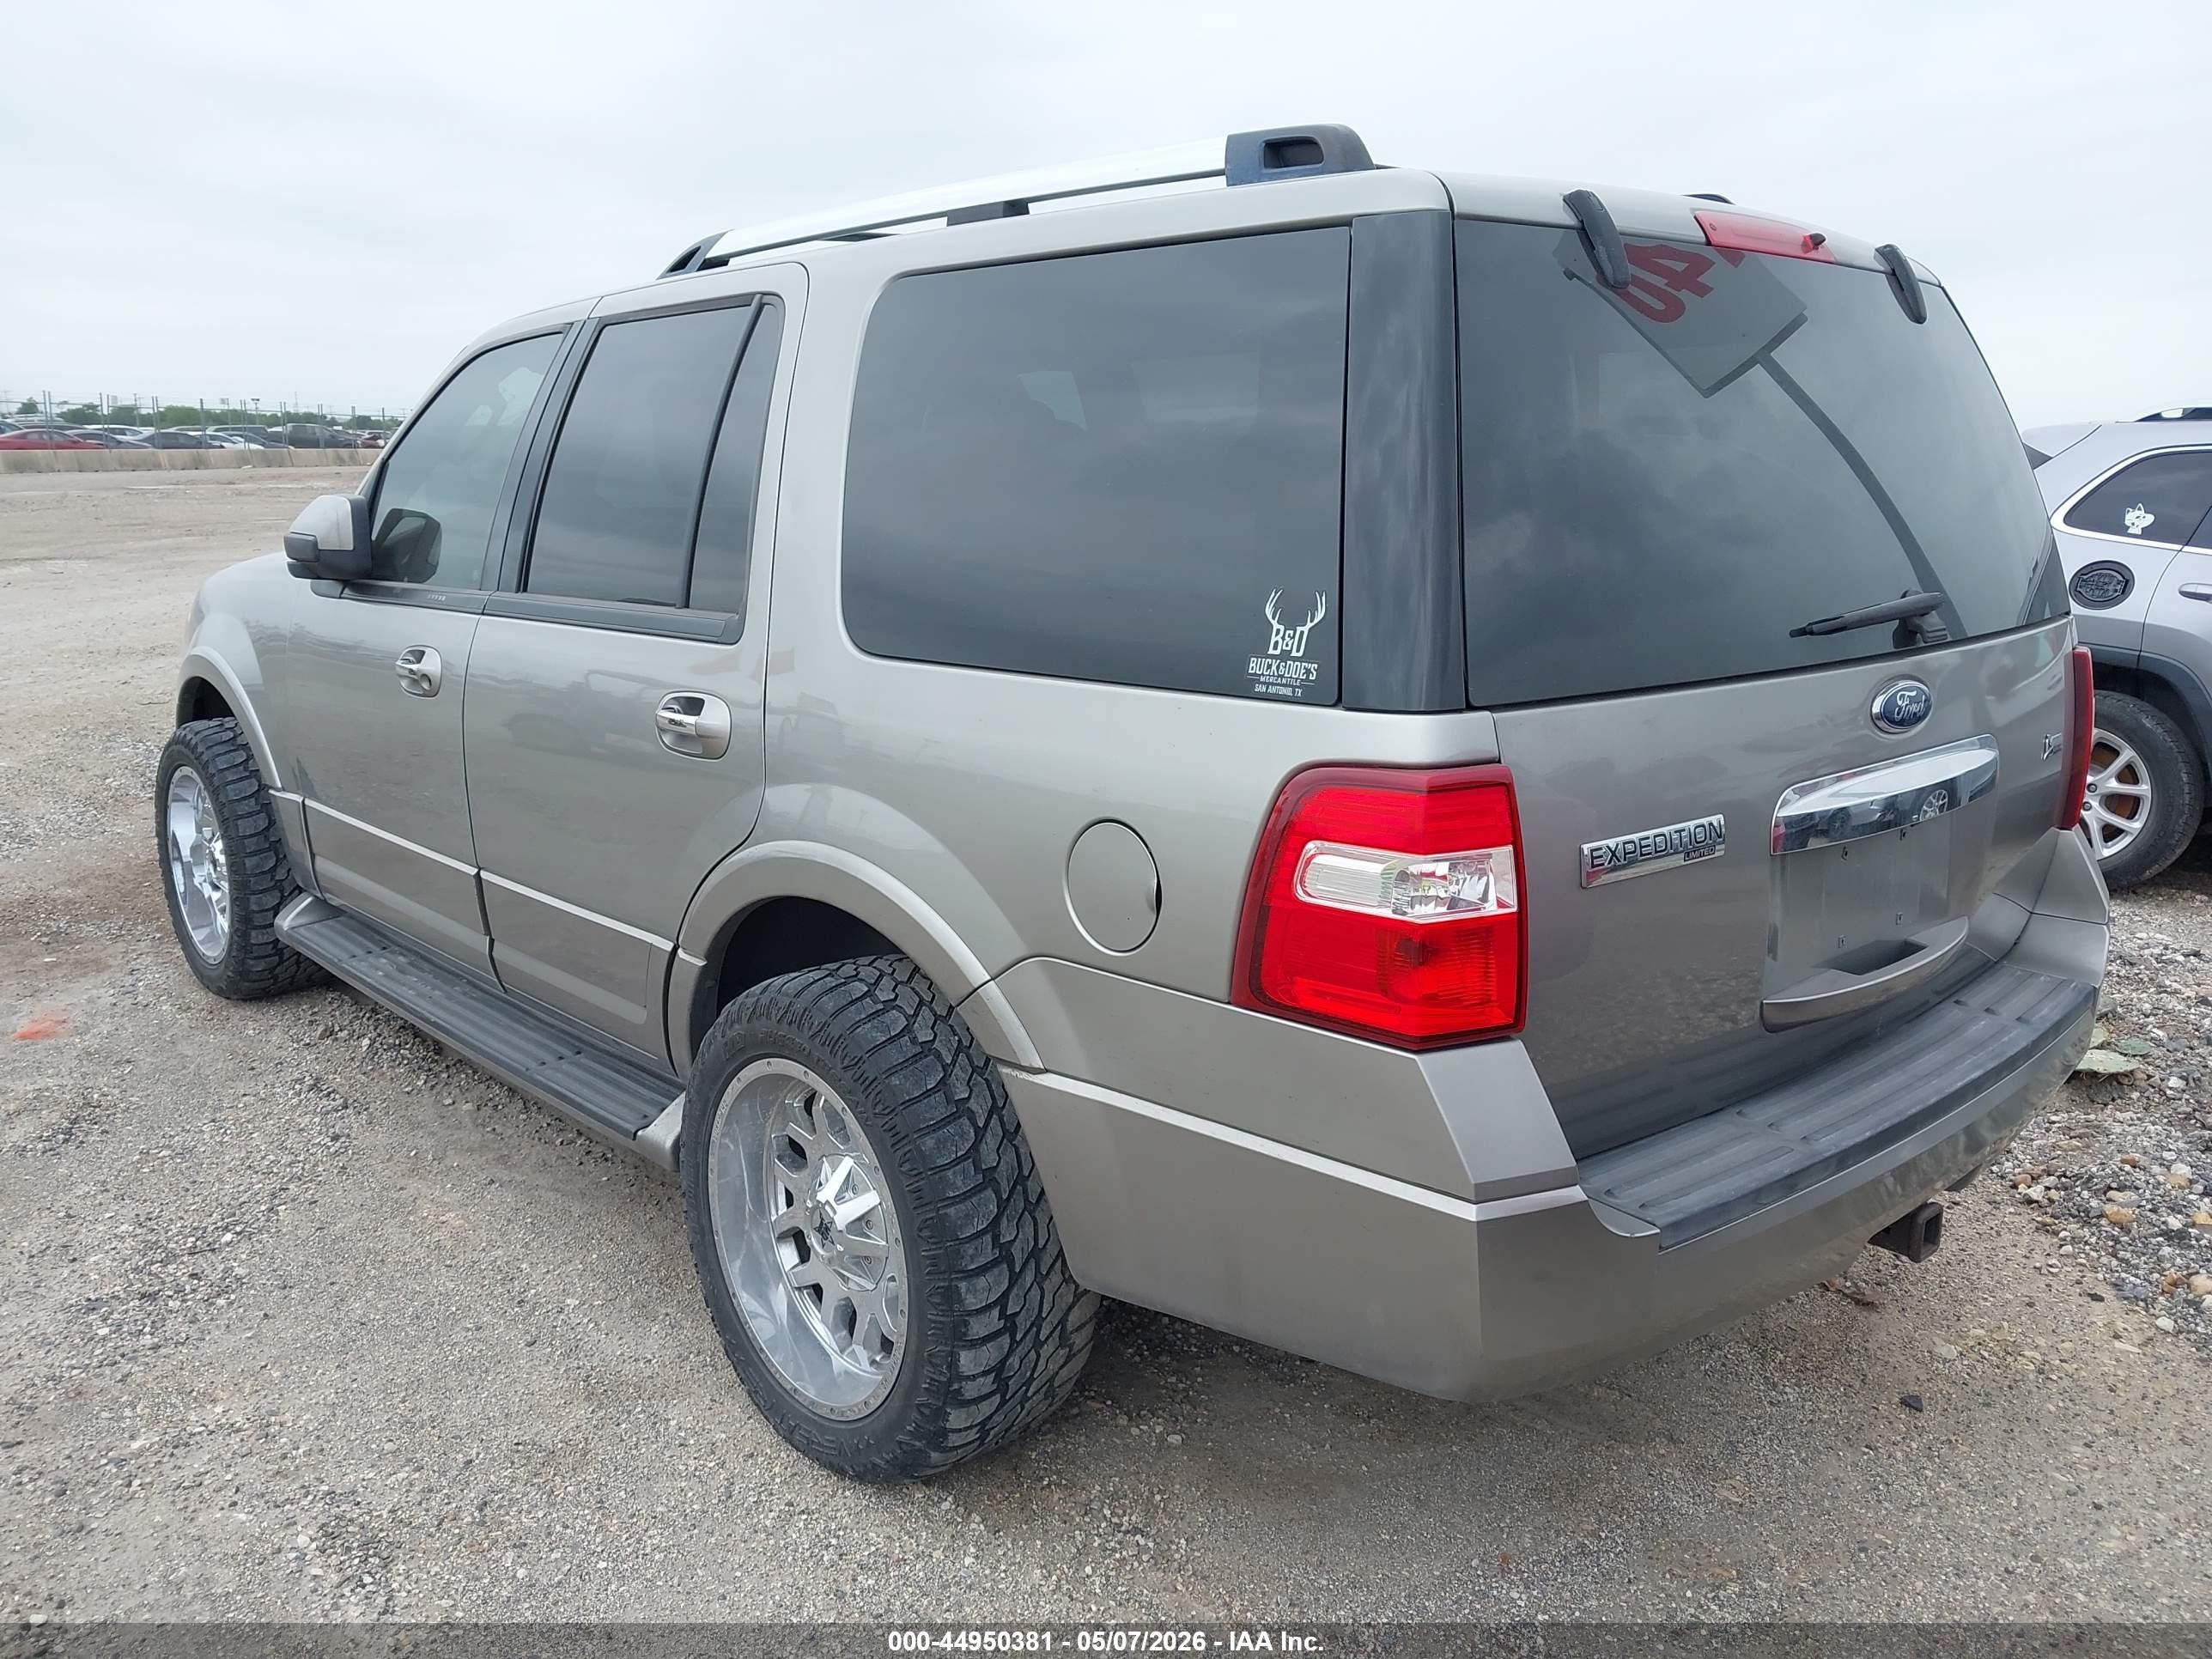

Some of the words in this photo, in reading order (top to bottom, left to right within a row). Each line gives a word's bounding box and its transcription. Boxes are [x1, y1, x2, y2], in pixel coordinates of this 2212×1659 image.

[1267, 624, 1310, 657] B&D
[1248, 657, 1319, 680] BUCK&DOE'S
[1254, 684, 1267, 693] SAN
[1294, 688, 1304, 697] TX
[1260, 675, 1302, 686] MERCANTILE
[1894, 690, 1926, 722] Ford
[1589, 818, 1724, 869] EXPEDITION
[1685, 846, 1716, 861] LIMITED
